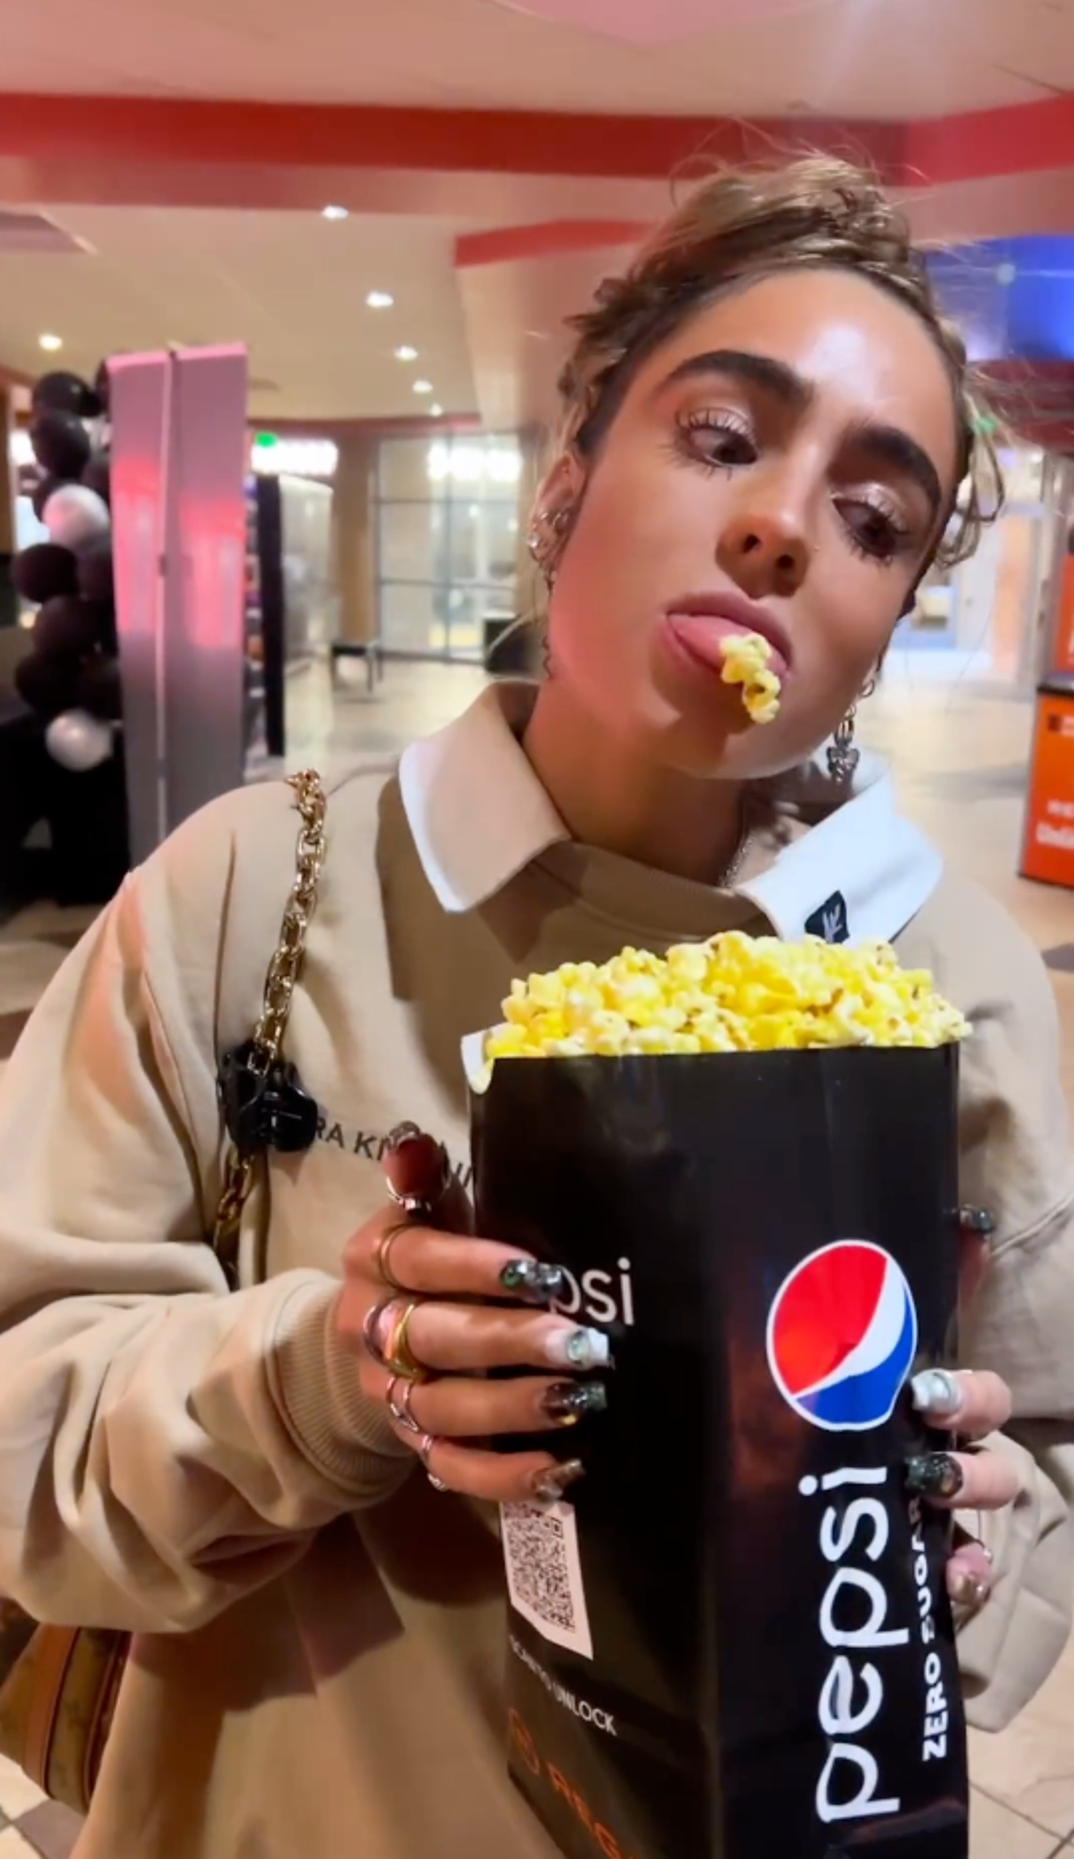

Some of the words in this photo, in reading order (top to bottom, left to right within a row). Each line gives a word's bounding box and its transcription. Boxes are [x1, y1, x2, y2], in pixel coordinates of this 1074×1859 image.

[798, 1466, 909, 1823] pepsi
[552, 1681, 618, 1736] UNLOCK
[922, 1652, 949, 1762] ZERO
